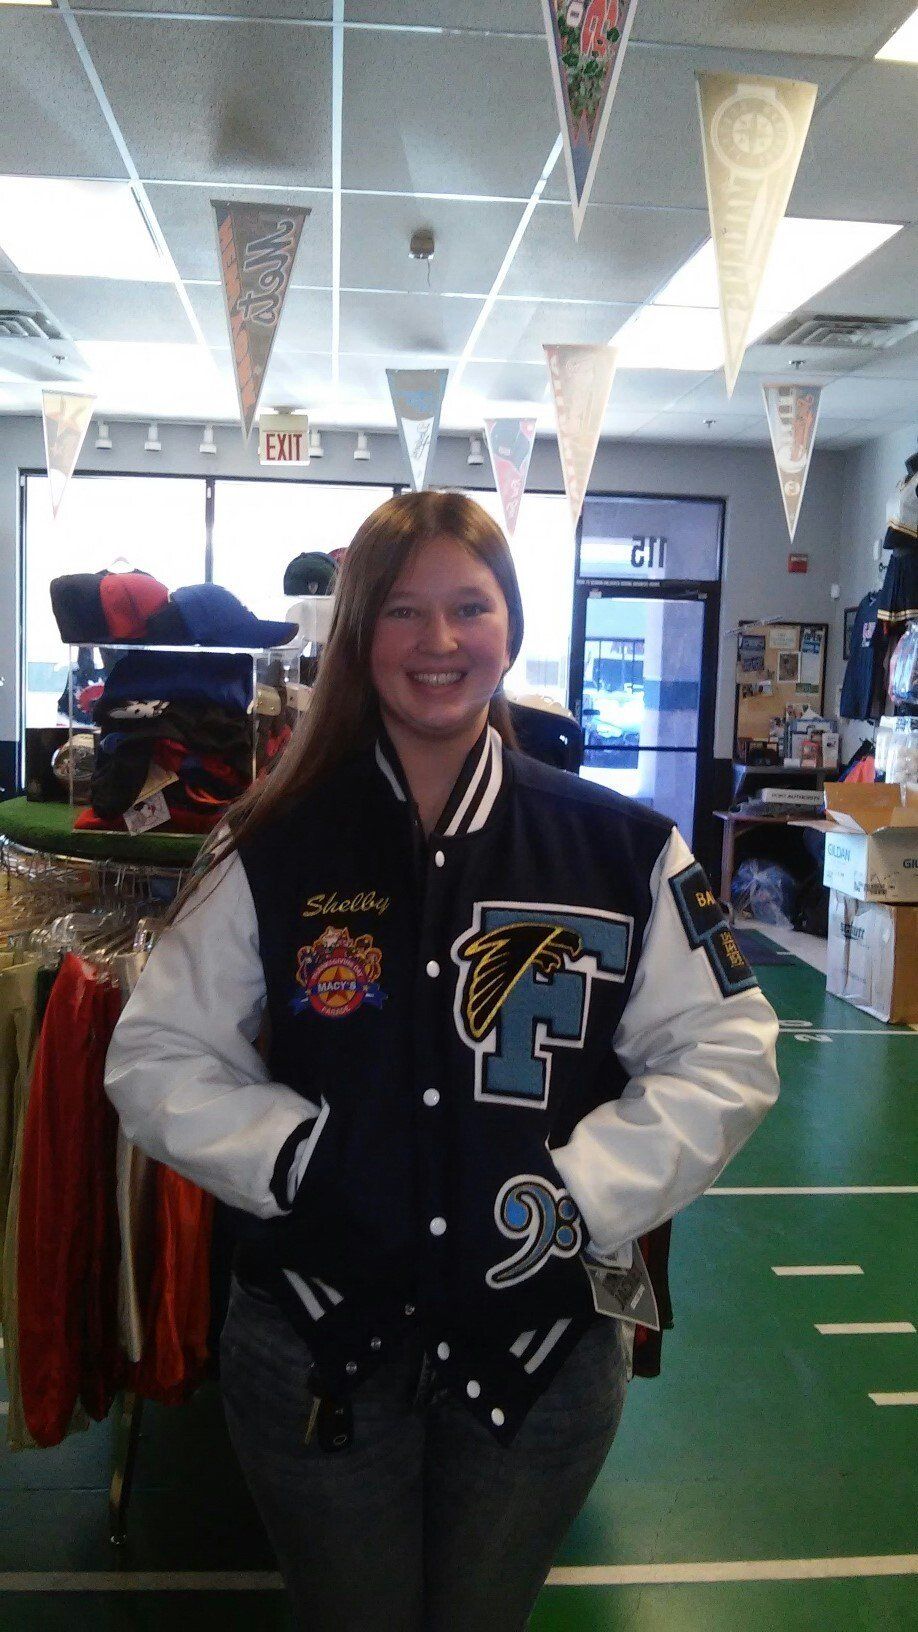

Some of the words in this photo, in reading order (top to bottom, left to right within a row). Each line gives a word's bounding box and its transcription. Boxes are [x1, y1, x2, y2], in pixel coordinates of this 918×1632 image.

[265, 433, 302, 461] EXIT
[828, 843, 851, 862] GILDAN
[302, 891, 390, 918] Shelby
[317, 981, 357, 993] MACY'S
